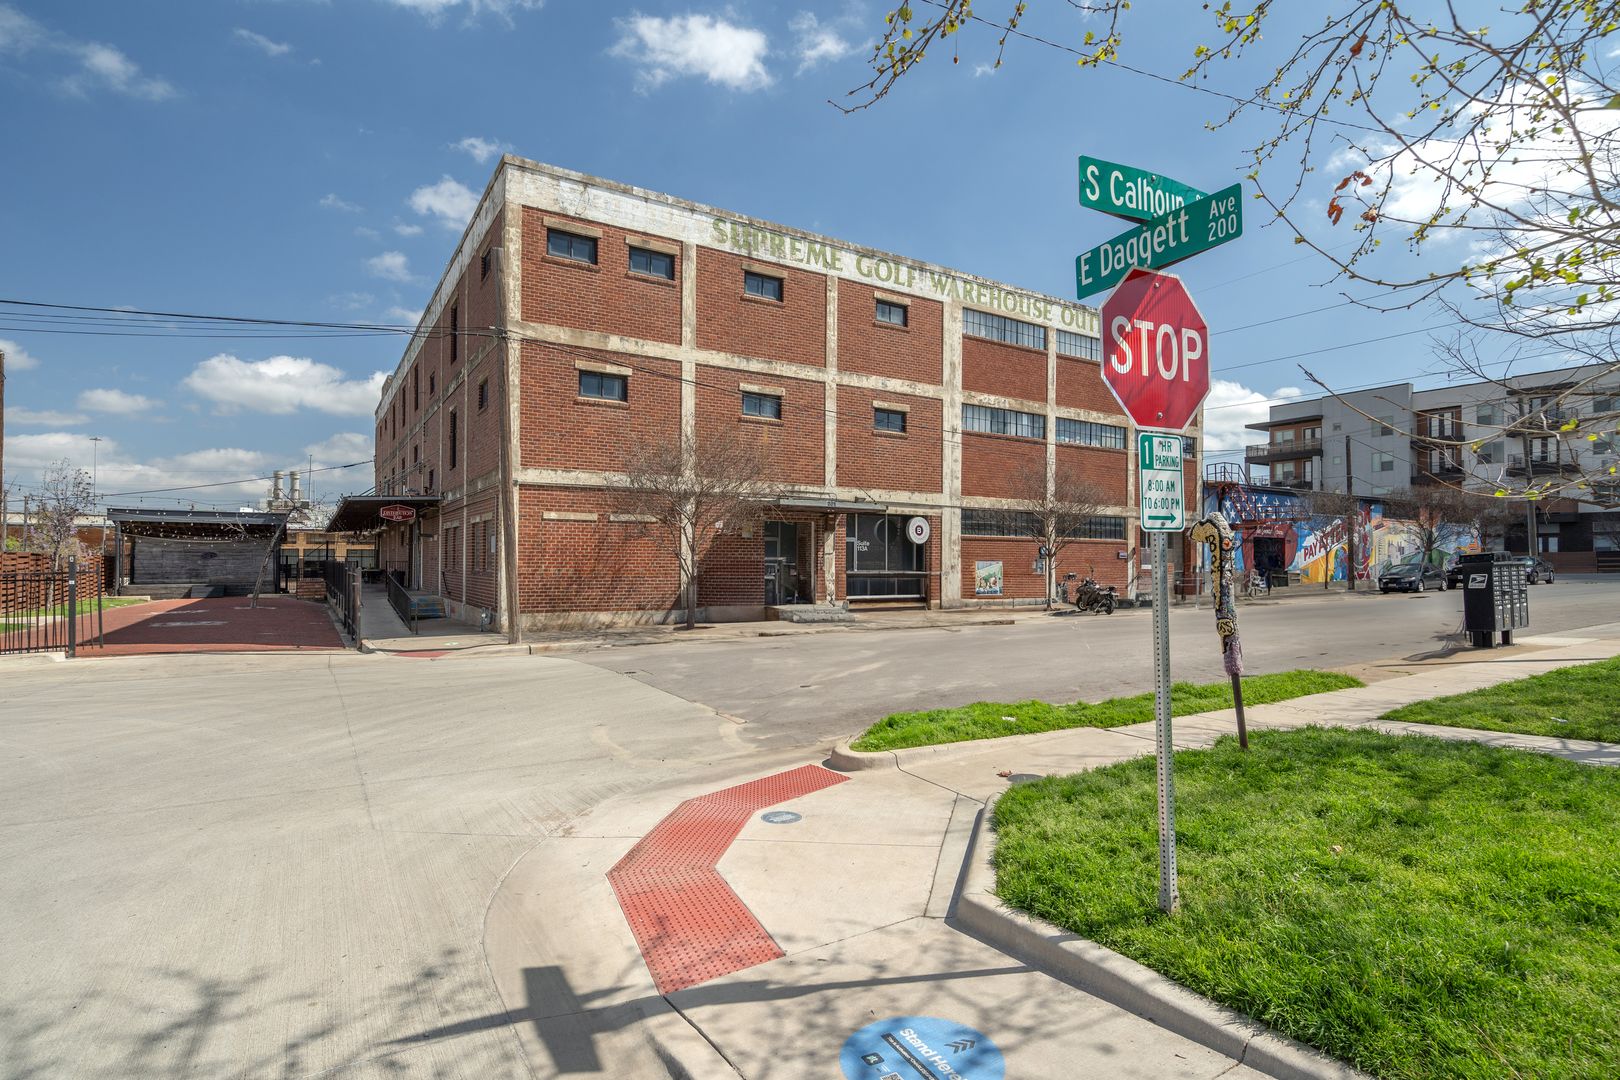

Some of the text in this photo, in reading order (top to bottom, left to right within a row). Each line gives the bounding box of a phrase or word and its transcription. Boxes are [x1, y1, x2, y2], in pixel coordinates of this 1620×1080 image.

[1086, 165, 1185, 216] S Calhoun
[1209, 196, 1235, 220] Ave
[1207, 214, 1237, 242] 200
[1080, 208, 1190, 287] E Daggett
[712, 218, 843, 272] SUPREME
[855, 254, 919, 288] GOLF
[929, 271, 1052, 321] WAREHOUSE
[1110, 315, 1203, 382] STOP
[1144, 441, 1149, 464] 1
[1161, 441, 1172, 453] HR
[1155, 455, 1179, 468] PARKING
[1147, 479, 1175, 492] 8:00 AM
[1144, 497, 1180, 510] TO 6:00 PM
[1303, 540, 1319, 561] PAY
[899, 1028, 938, 1057] Stand
[928, 1055, 961, 1080] Here
